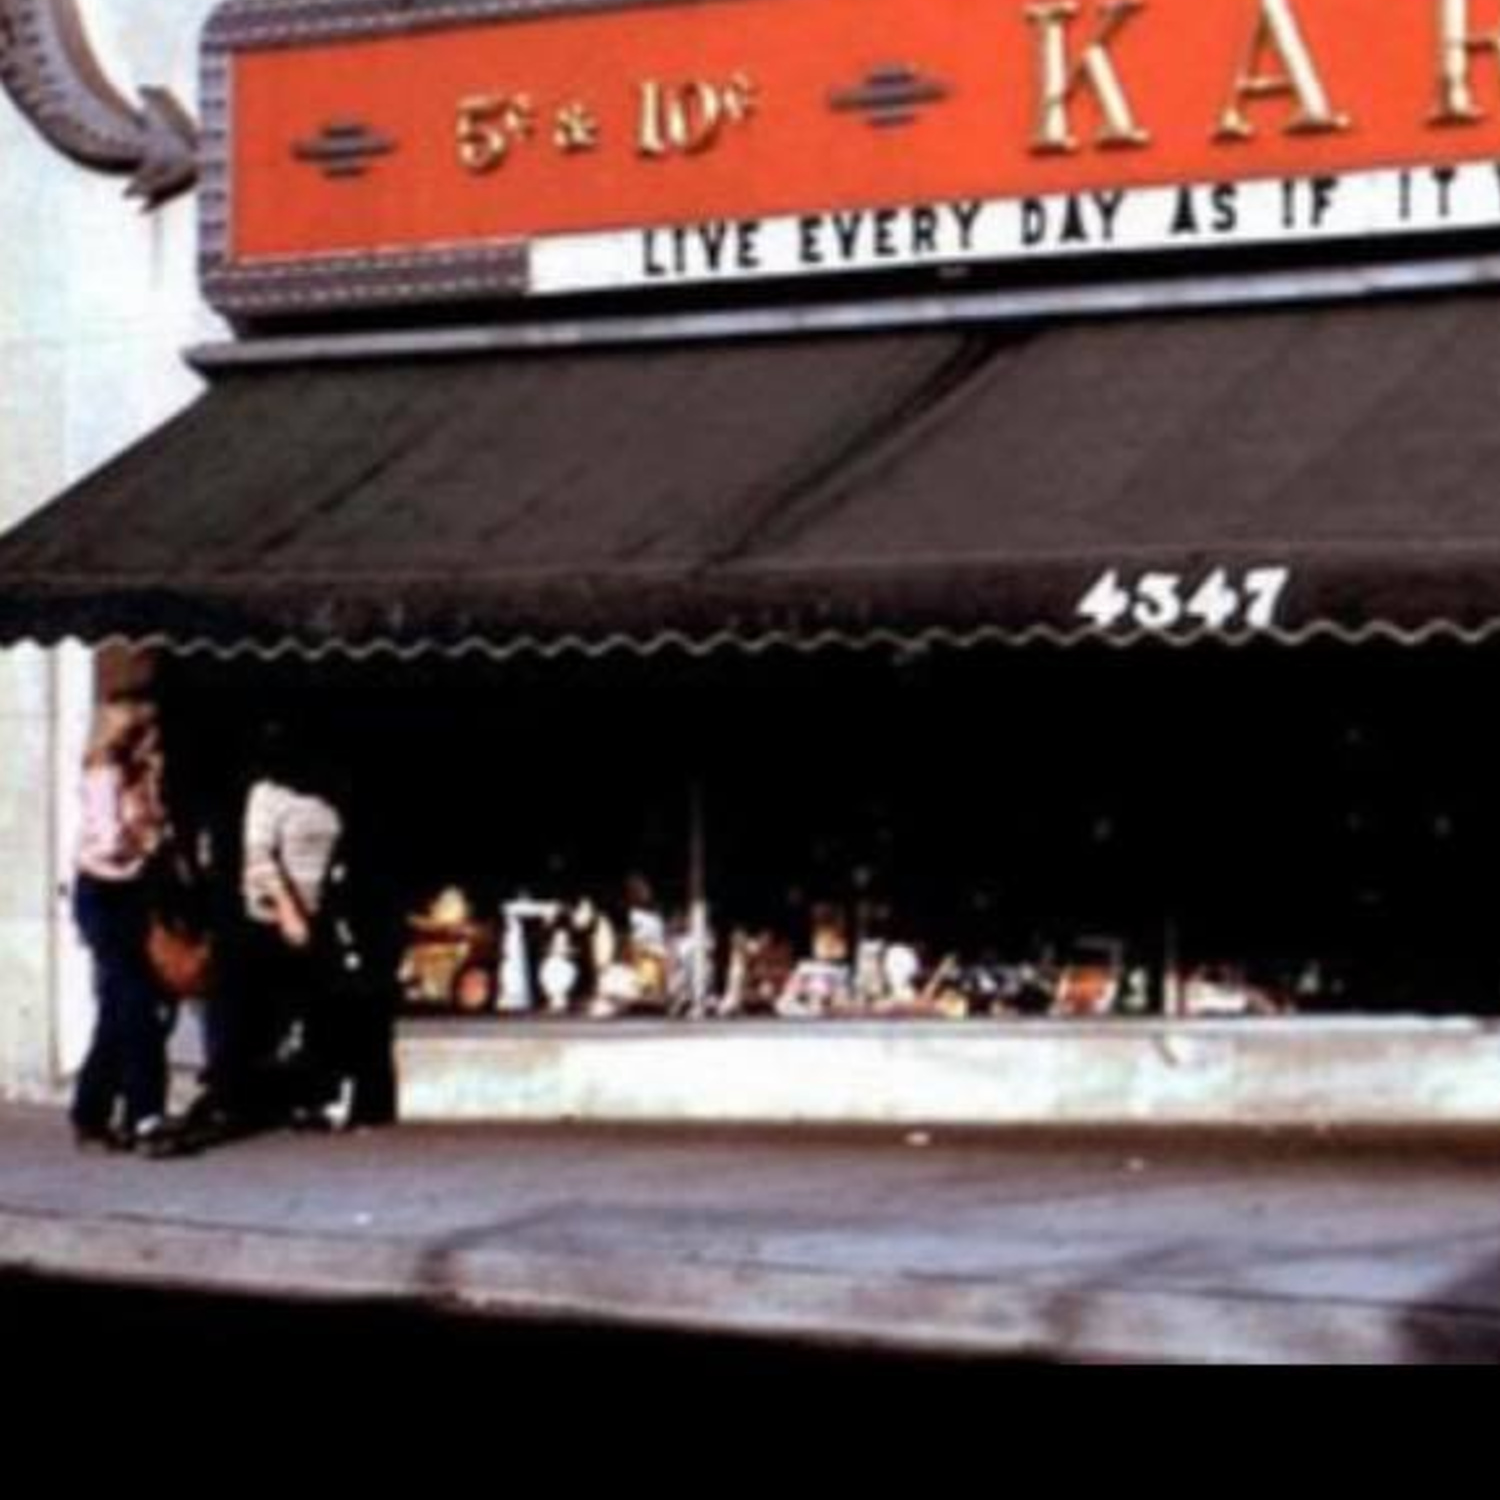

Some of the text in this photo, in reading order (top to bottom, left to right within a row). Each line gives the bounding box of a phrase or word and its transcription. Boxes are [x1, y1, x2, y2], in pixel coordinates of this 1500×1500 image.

[642, 220, 761, 277] LIVE
[800, 202, 982, 263] EVERY
[1021, 190, 1123, 246] DAY
[1170, 182, 1237, 235] AS
[1282, 176, 1338, 230] IF
[1398, 167, 1456, 220] IT
